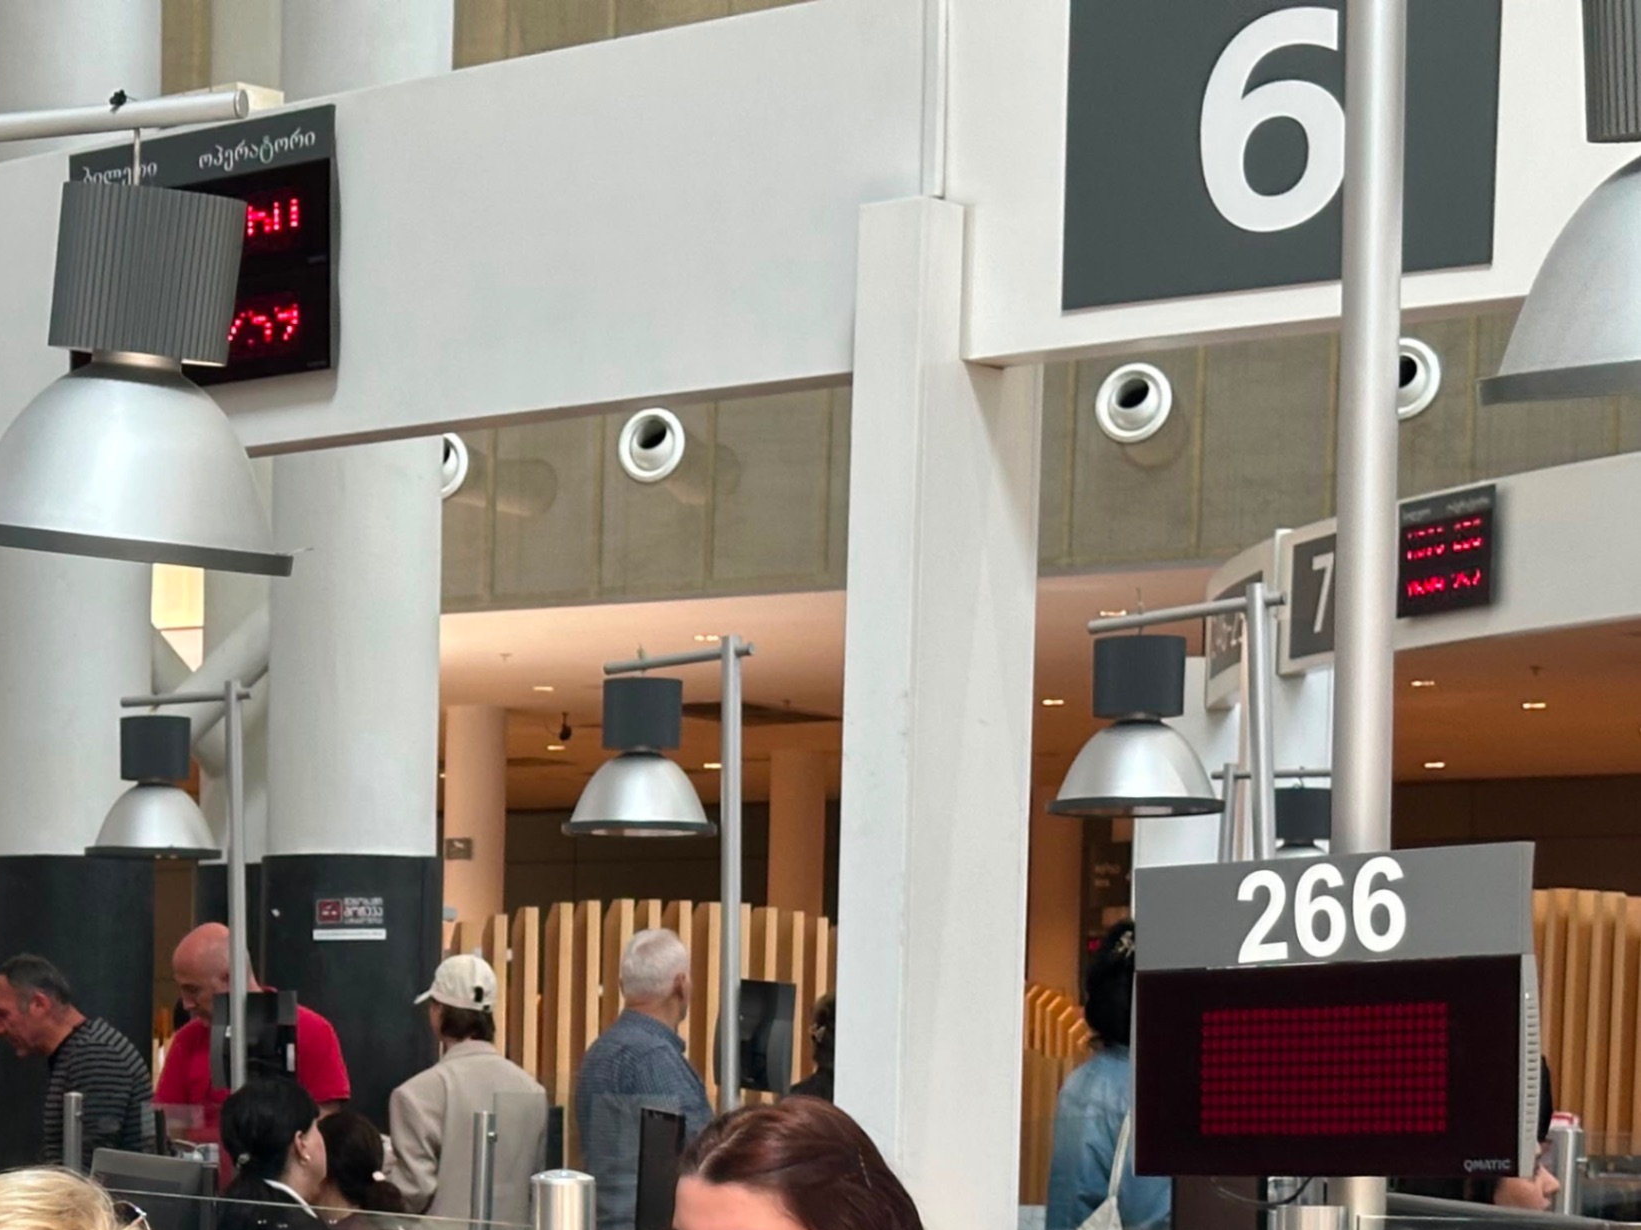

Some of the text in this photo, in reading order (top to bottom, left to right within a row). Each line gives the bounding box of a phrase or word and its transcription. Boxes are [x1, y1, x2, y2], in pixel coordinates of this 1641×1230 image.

[198, 127, 316, 171] ოპერატორი
[1200, 6, 1346, 232] 6
[1312, 552, 1334, 633] 7
[1237, 856, 1407, 964] 266
[1463, 1158, 1511, 1172] QMATIC
